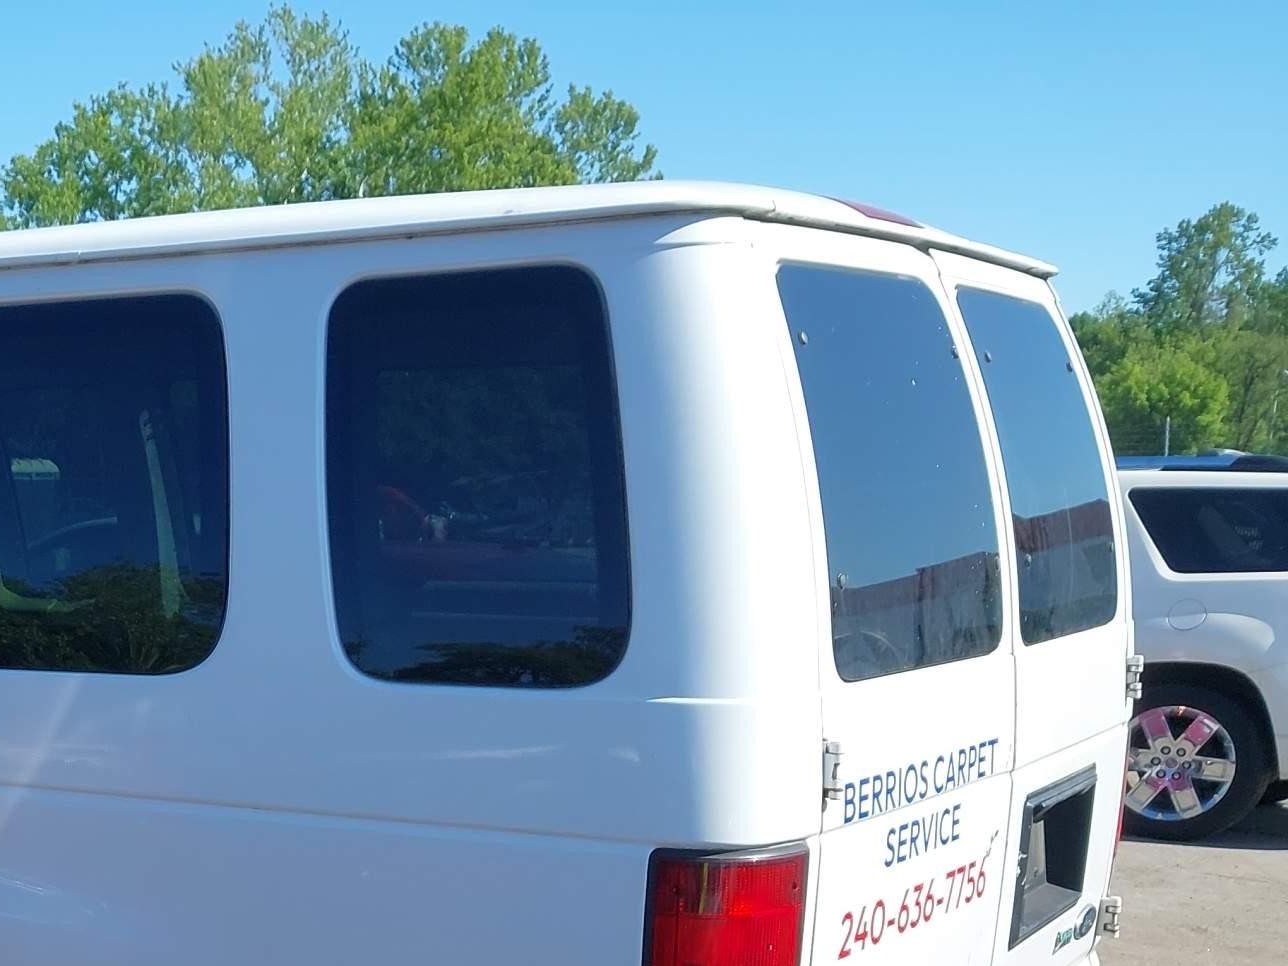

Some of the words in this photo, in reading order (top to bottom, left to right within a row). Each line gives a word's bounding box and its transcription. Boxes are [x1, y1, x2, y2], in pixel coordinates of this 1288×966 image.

[844, 760, 929, 824] BERRIOS
[933, 738, 999, 794] CARPET
[884, 803, 961, 868] SERVICE
[837, 859, 988, 961] 240-636-7756
